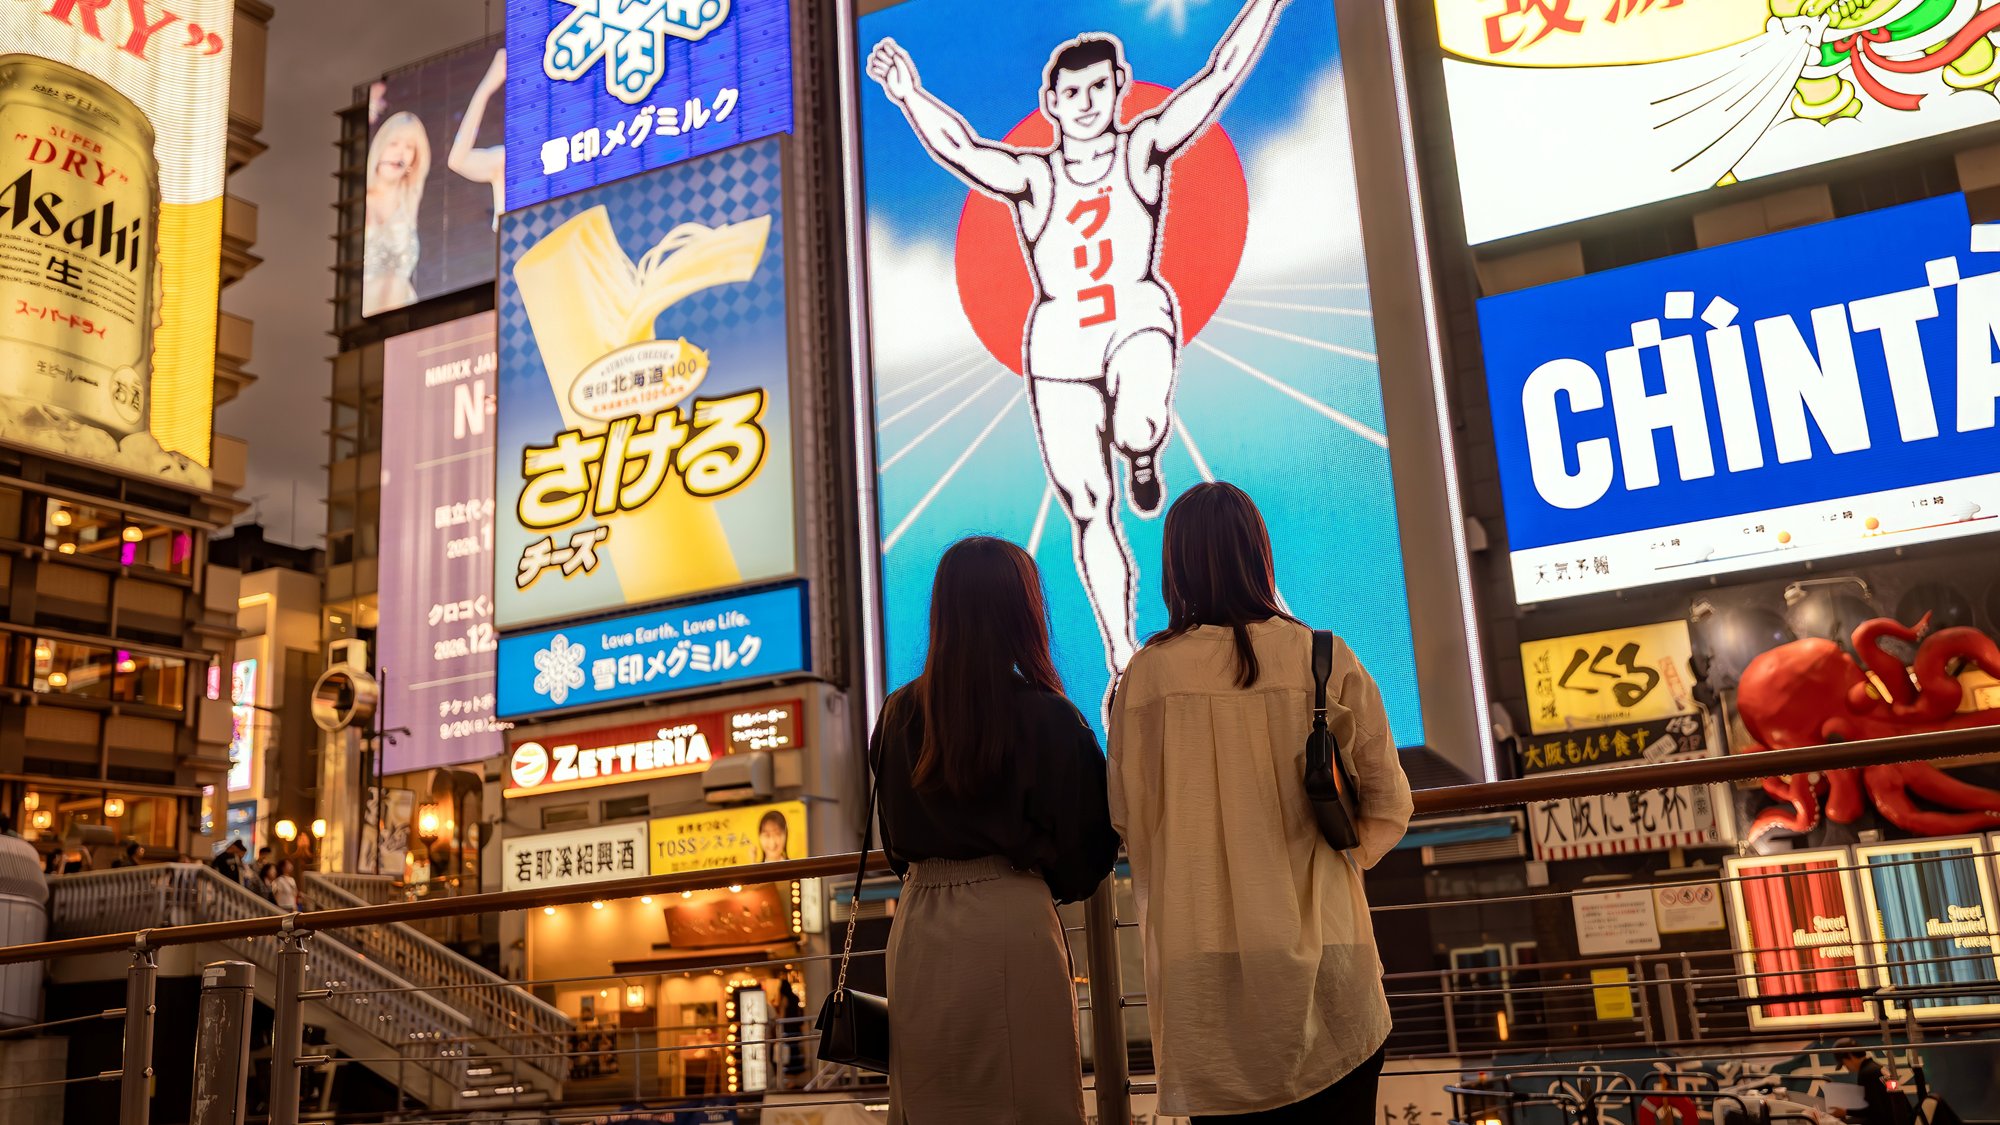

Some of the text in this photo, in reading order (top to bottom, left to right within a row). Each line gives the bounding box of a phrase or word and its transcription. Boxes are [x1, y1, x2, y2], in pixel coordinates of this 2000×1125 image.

[49, 124, 103, 154] SUPER
[541, 88, 739, 175] 雪印メグミルク
[0, 168, 141, 272] Asahi
[46, 256, 82, 290] 生
[1065, 186, 1116, 329] グリコ
[16, 300, 107, 339] スーパードライ
[425, 358, 471, 388] NMIXX
[517, 387, 766, 529] さける
[516, 525, 609, 589] チーズ
[601, 610, 750, 650] Love Earth. Love Life.
[592, 634, 762, 691] 雪印メグミルク
[1558, 643, 1660, 707] くくる
[551, 733, 712, 783] ZETTERIA
